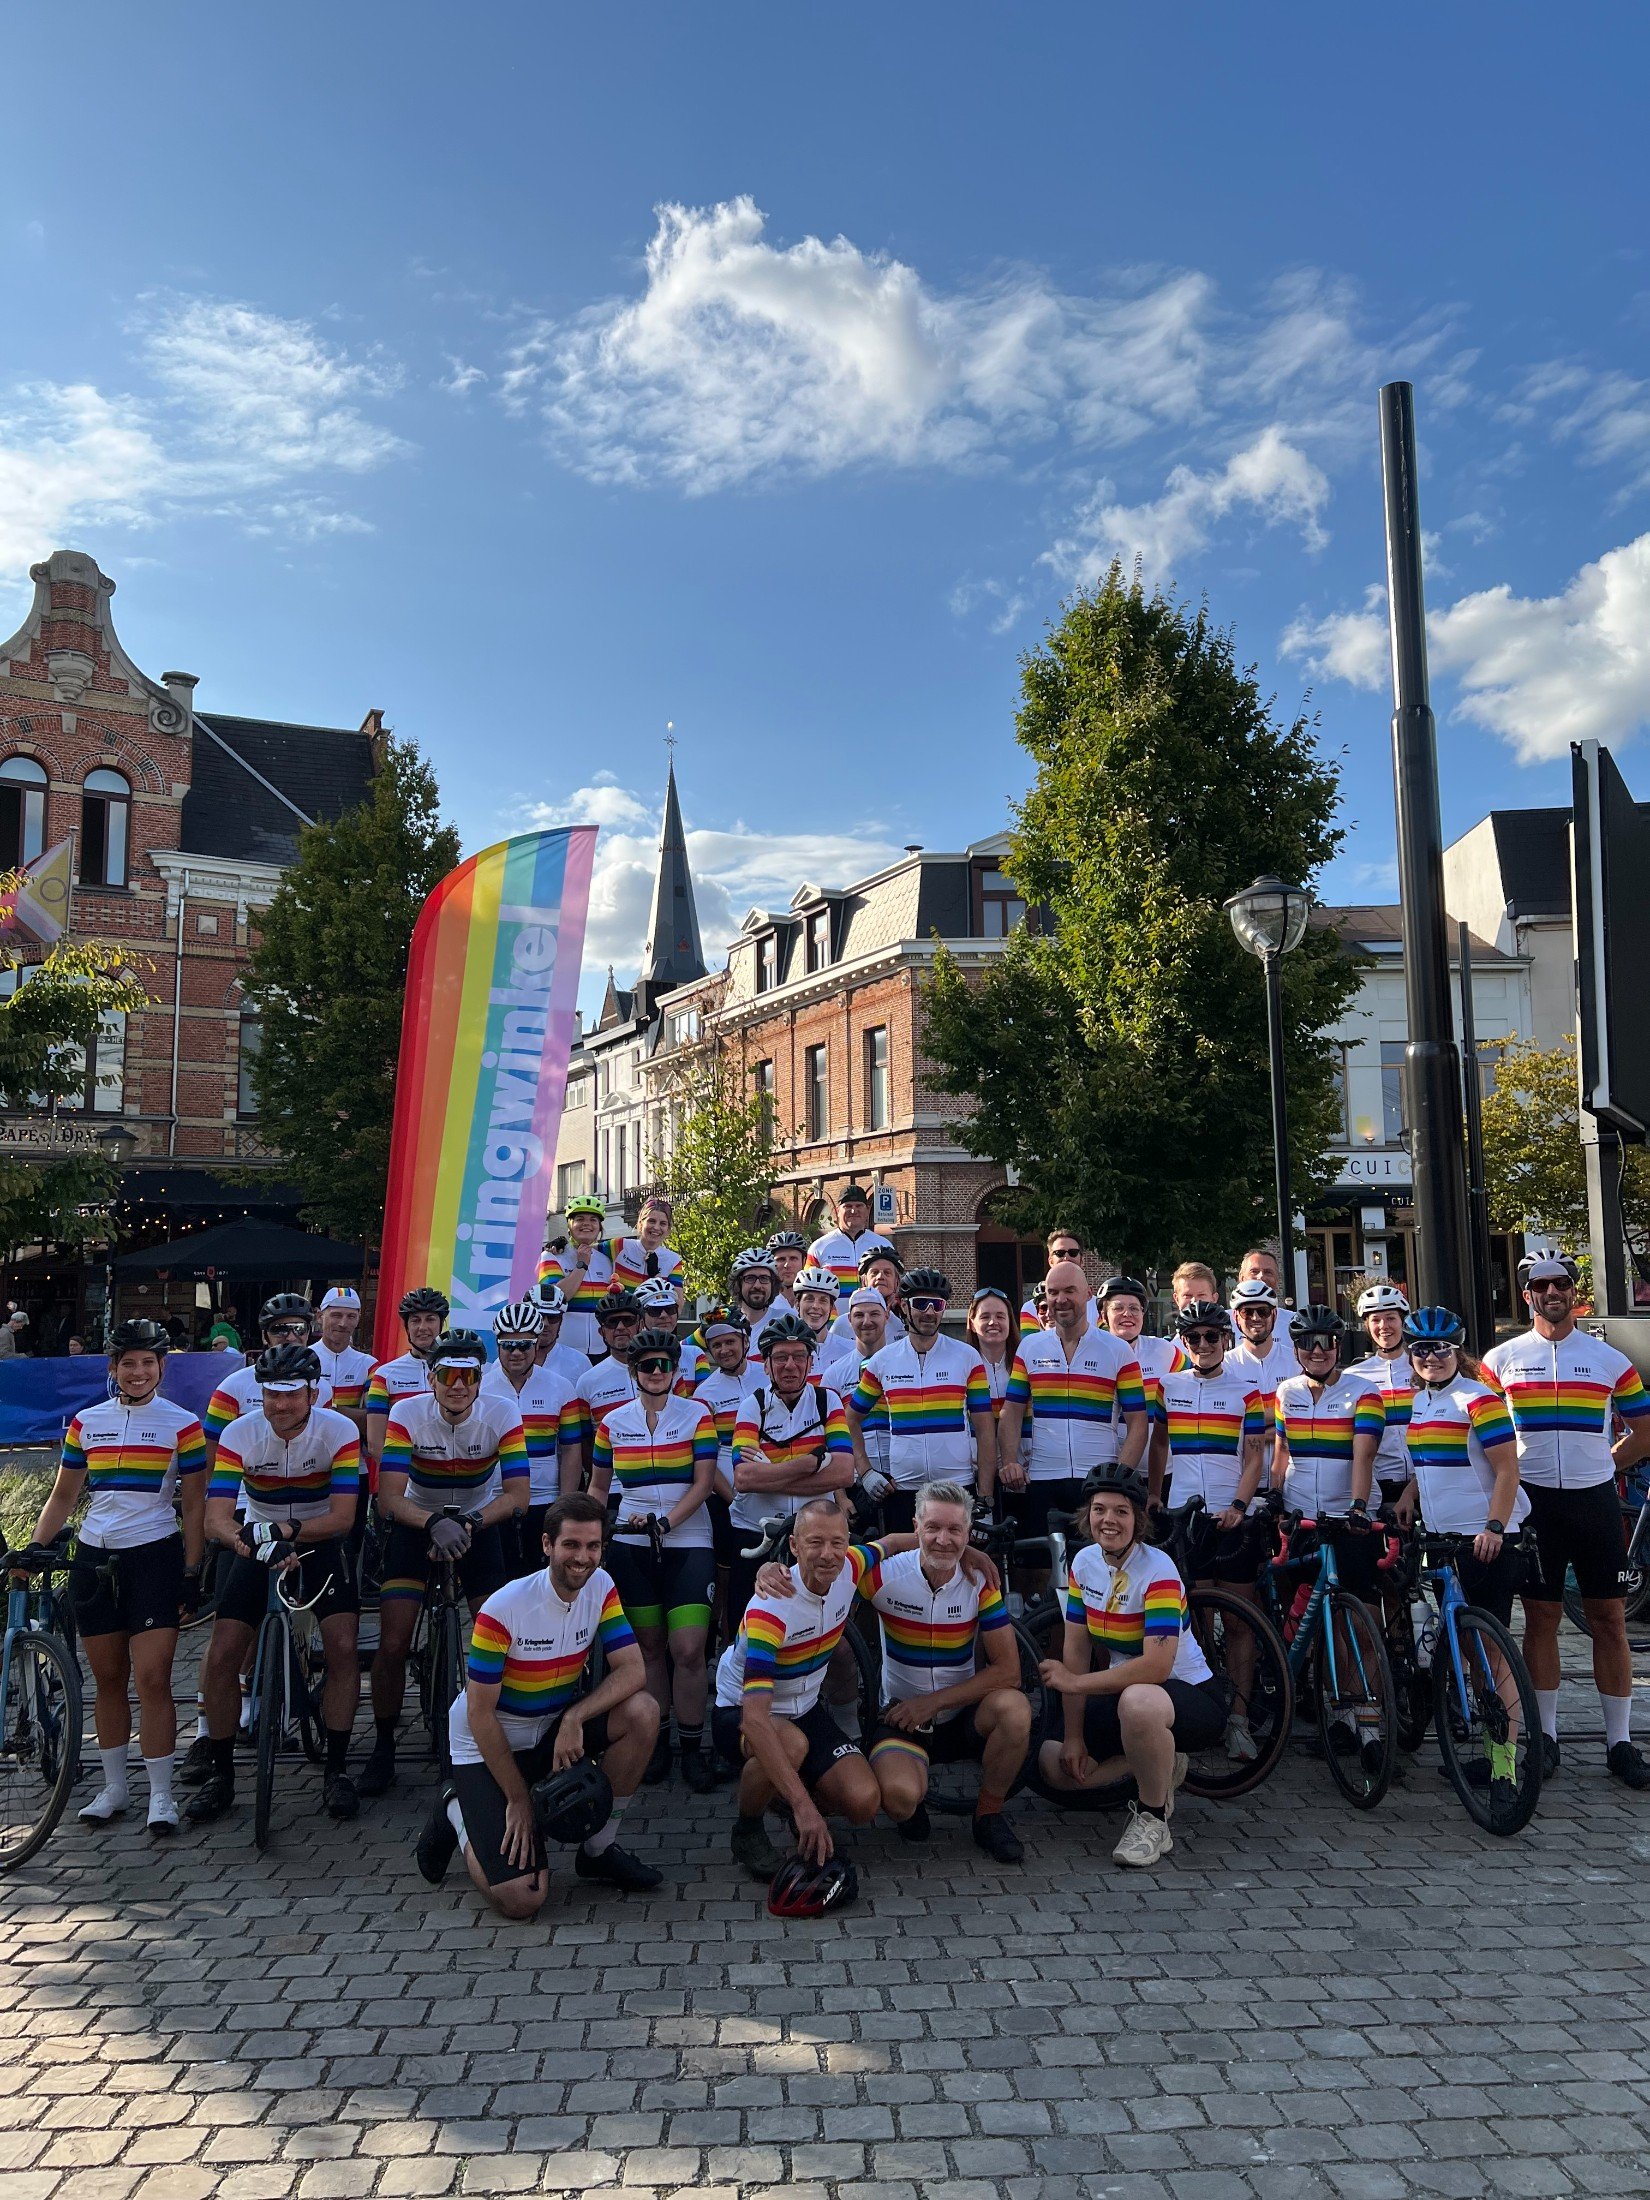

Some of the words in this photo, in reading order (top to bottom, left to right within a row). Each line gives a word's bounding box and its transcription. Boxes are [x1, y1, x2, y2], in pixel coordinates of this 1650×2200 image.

[448, 905, 561, 1330] Kringwinkel
[60, 1127, 98, 1142] DRA
[1350, 1160, 1410, 1175] CUIC
[882, 1195, 889, 1206] P
[1391, 1197, 1413, 1206] CUI
